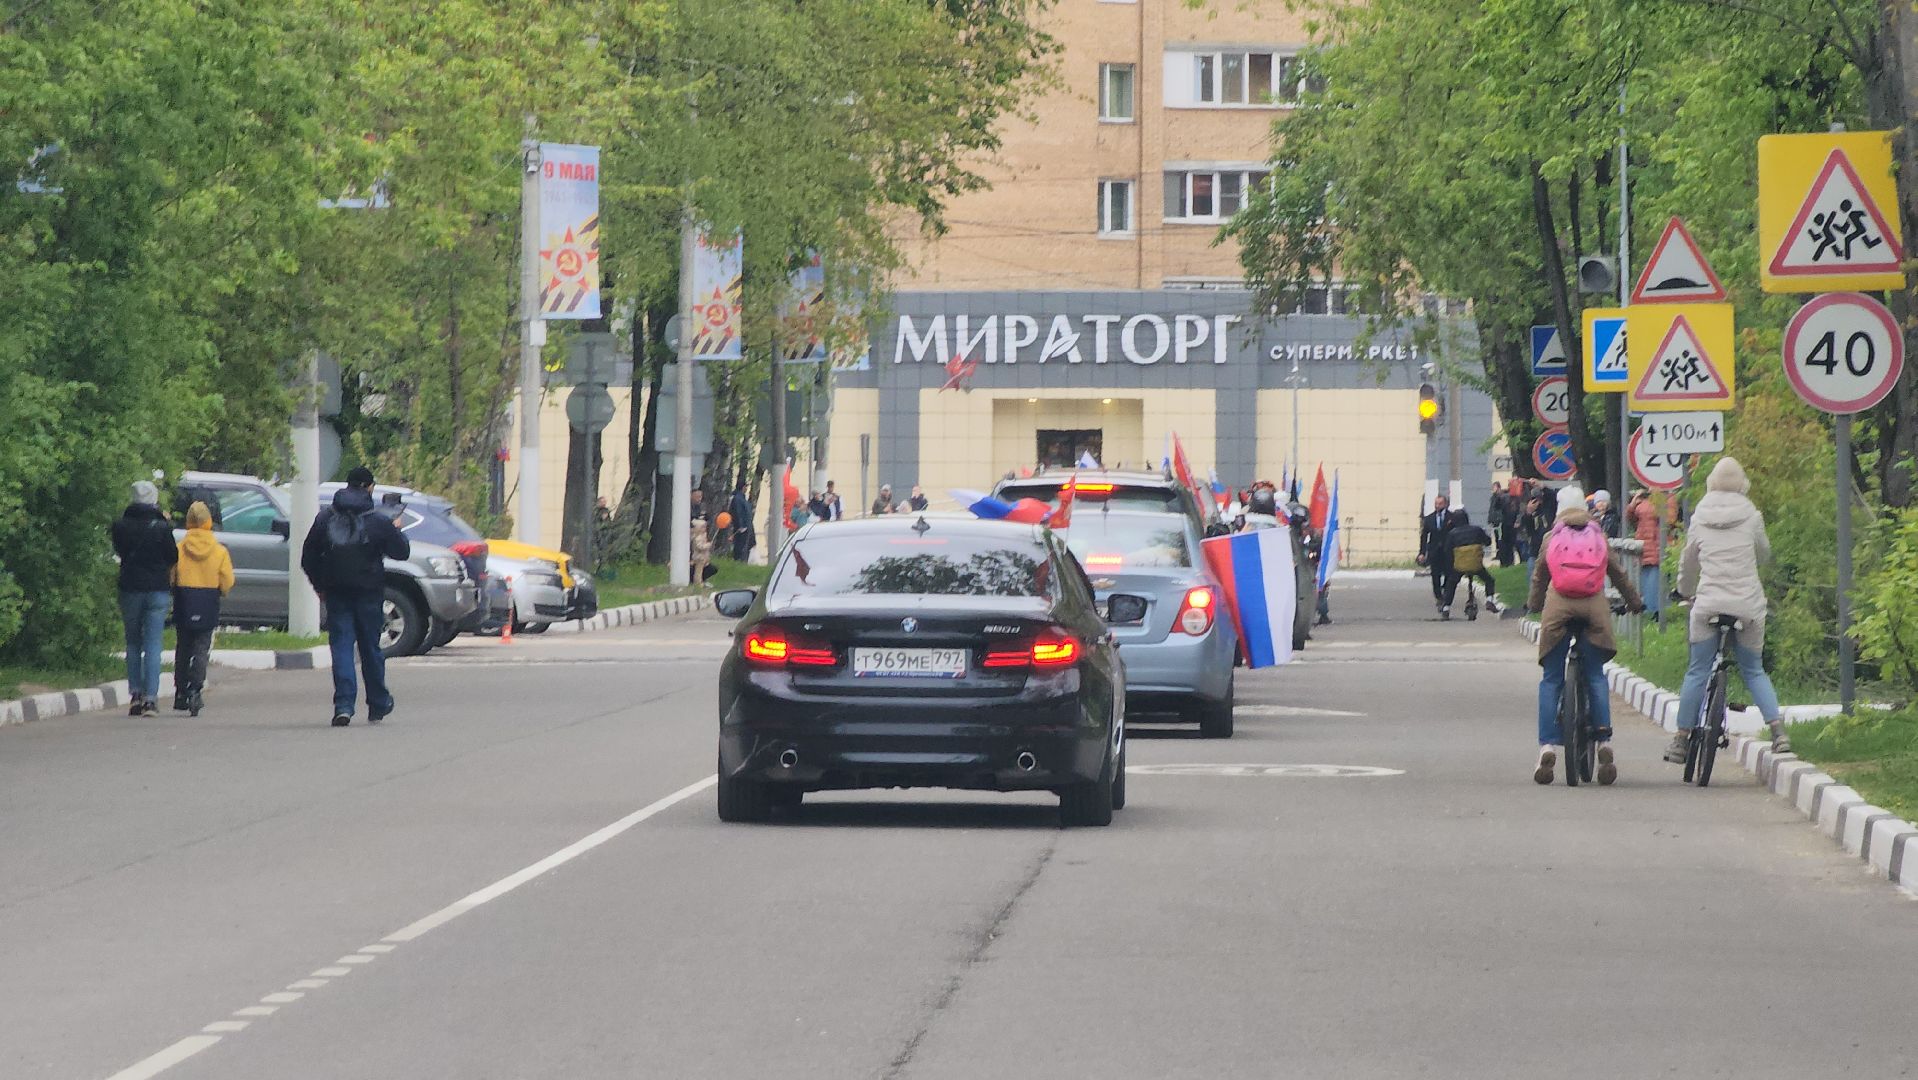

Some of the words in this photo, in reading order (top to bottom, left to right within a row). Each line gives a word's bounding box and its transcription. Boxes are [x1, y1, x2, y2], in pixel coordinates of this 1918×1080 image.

[544, 161, 554, 179] 9
[559, 162, 595, 182] МАЯ
[894, 314, 1242, 365] МИРАТОРГ
[1805, 331, 1875, 376] 40
[861, 651, 930, 669] Т969МЕ
[933, 651, 961, 665] 797
